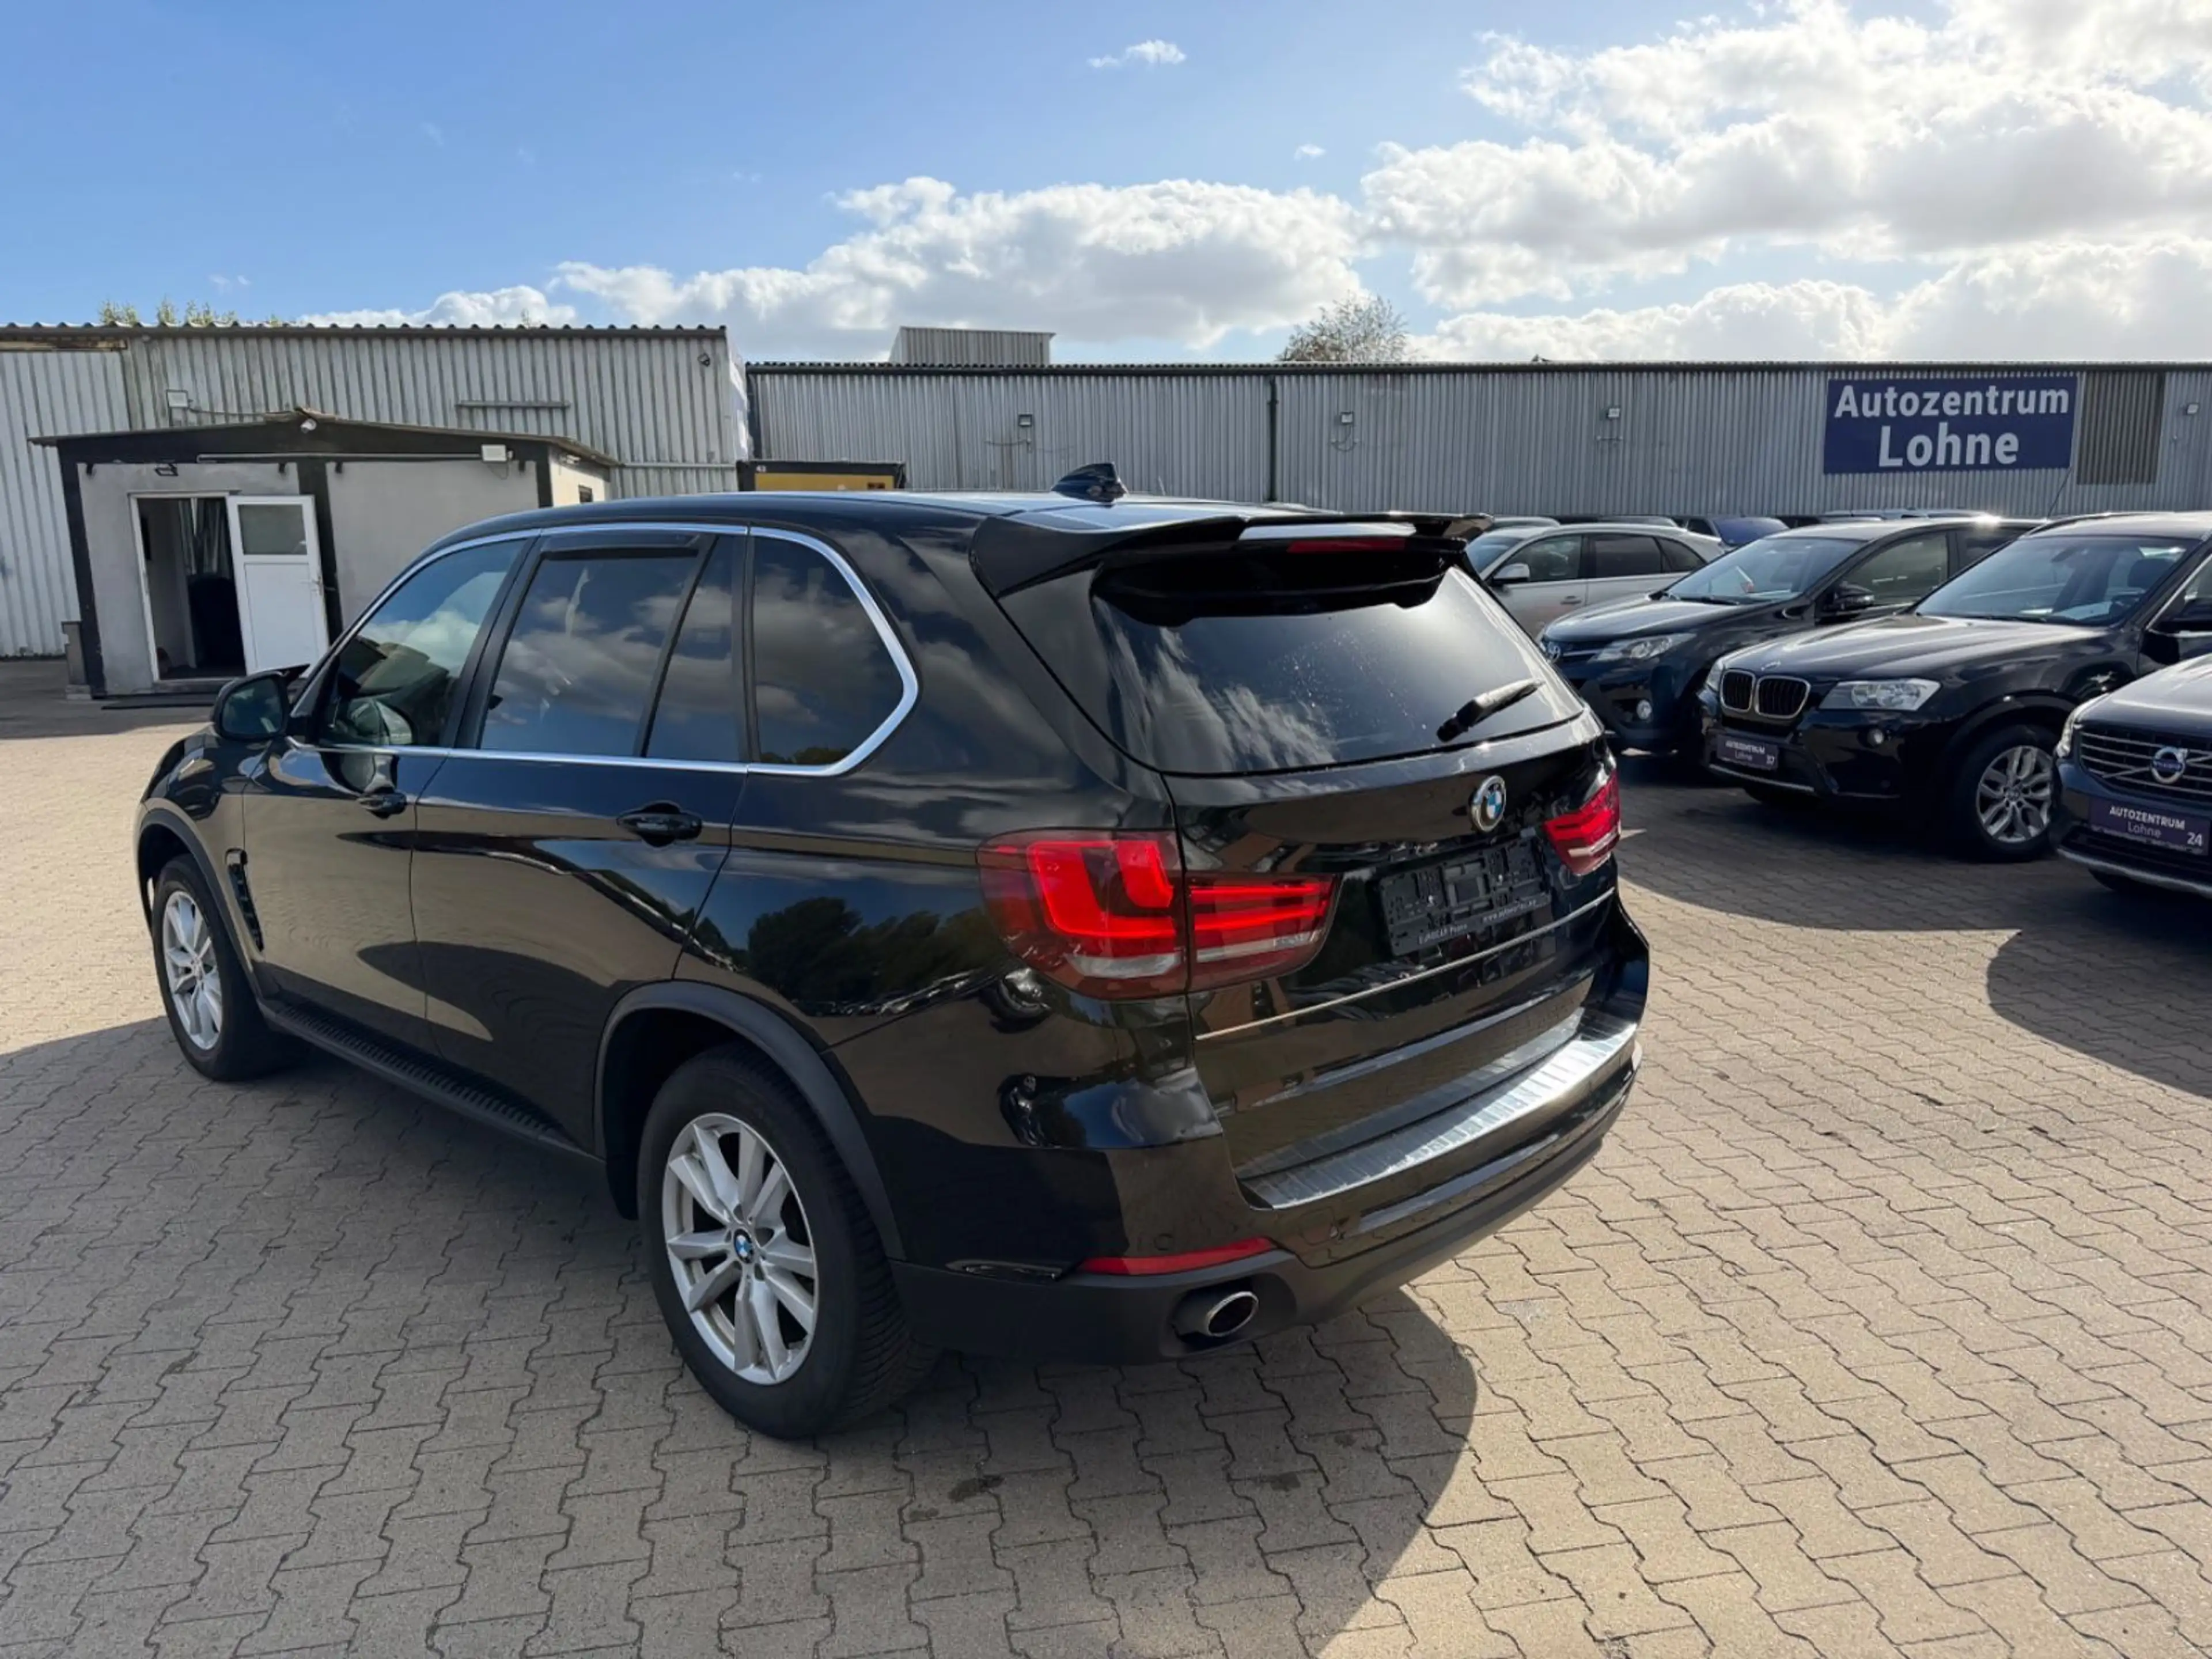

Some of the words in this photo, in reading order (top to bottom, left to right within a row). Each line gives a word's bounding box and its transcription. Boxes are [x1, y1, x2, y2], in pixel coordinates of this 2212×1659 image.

[1834, 385, 2070, 418] Autozentrum
[1878, 422, 2020, 467] Lohne
[2109, 804, 2186, 831] AUTOZENTRUM
[2127, 821, 2162, 838] Lohne
[2186, 831, 2203, 847] 24
